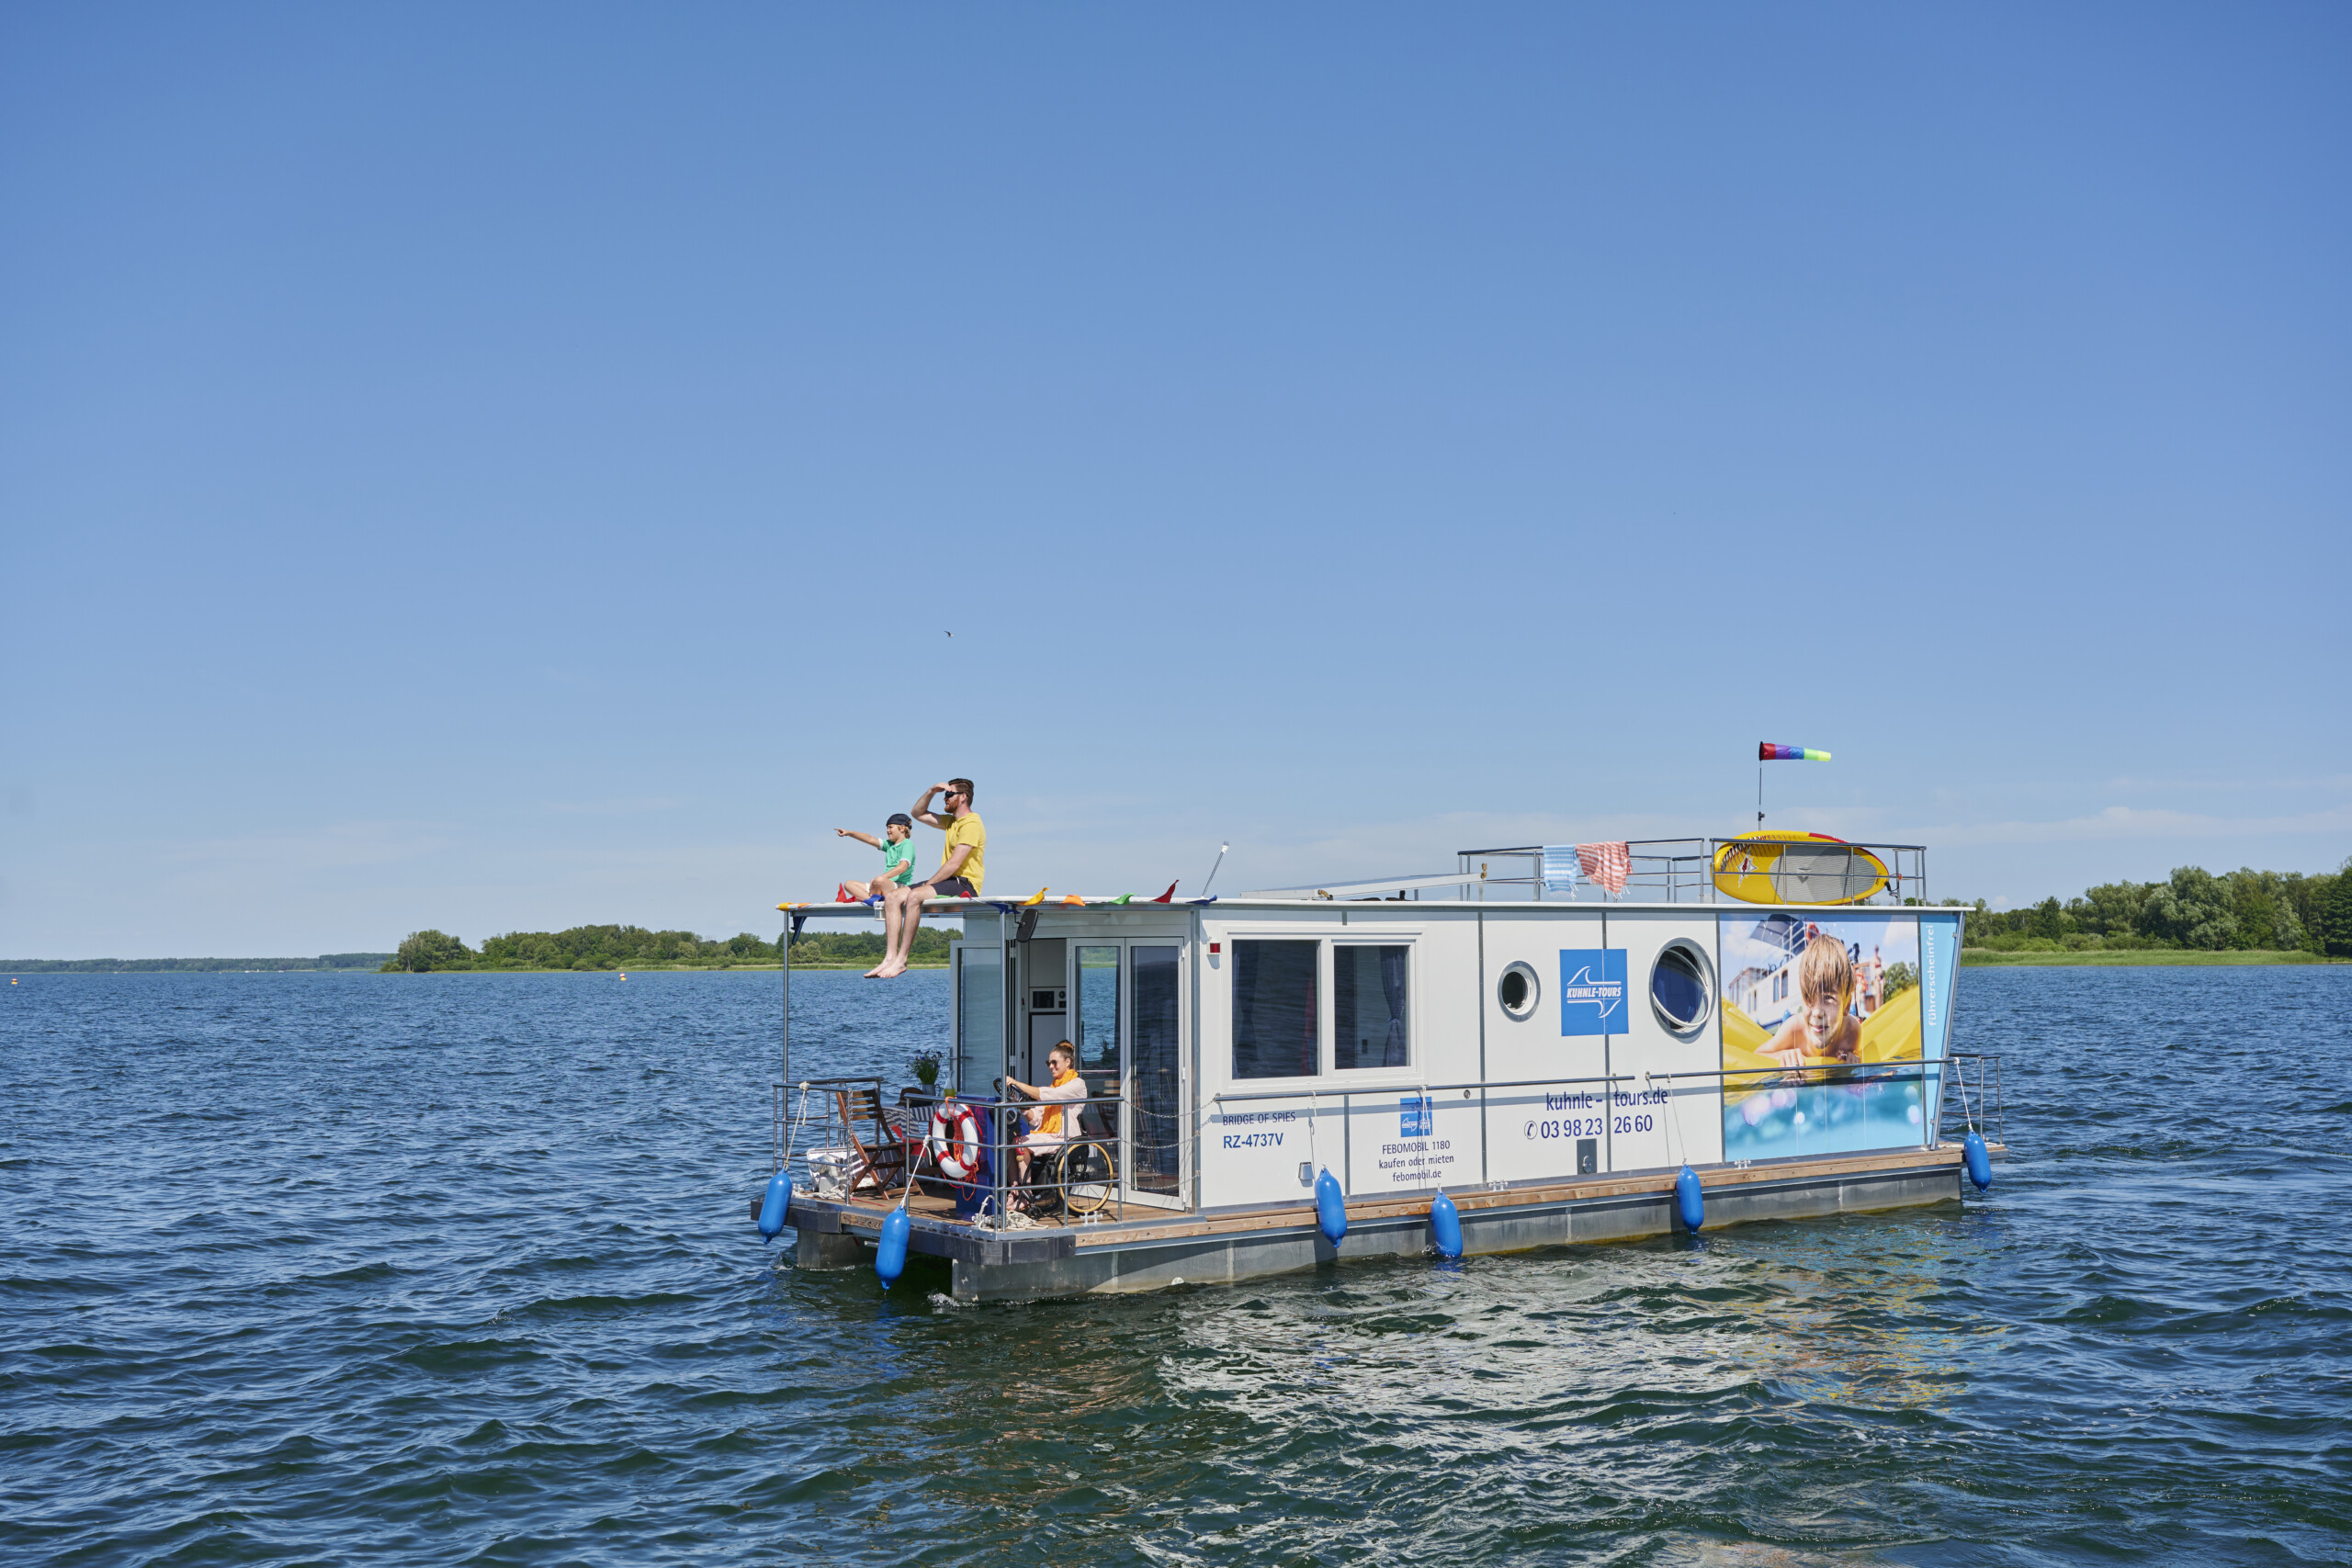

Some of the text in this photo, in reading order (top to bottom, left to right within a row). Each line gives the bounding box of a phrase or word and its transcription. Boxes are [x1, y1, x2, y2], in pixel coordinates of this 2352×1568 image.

[1926, 925, 1937, 1027] führerscheinfrei
[1566, 986, 1622, 998] KUHNLE-TOURS
[1613, 1087, 1668, 1107] tours.de
[1223, 1111, 1296, 1126] BRIDGE OF SPIES
[1541, 1114, 1653, 1138] 03 98 23 26 60
[1223, 1133, 1283, 1148] RZ-4737V
[1382, 1140, 1451, 1155] FEBOMOBIL 1180
[1378, 1155, 1454, 1169] kaufen oder mieten
[1393, 1169, 1442, 1182] febomobil.de
